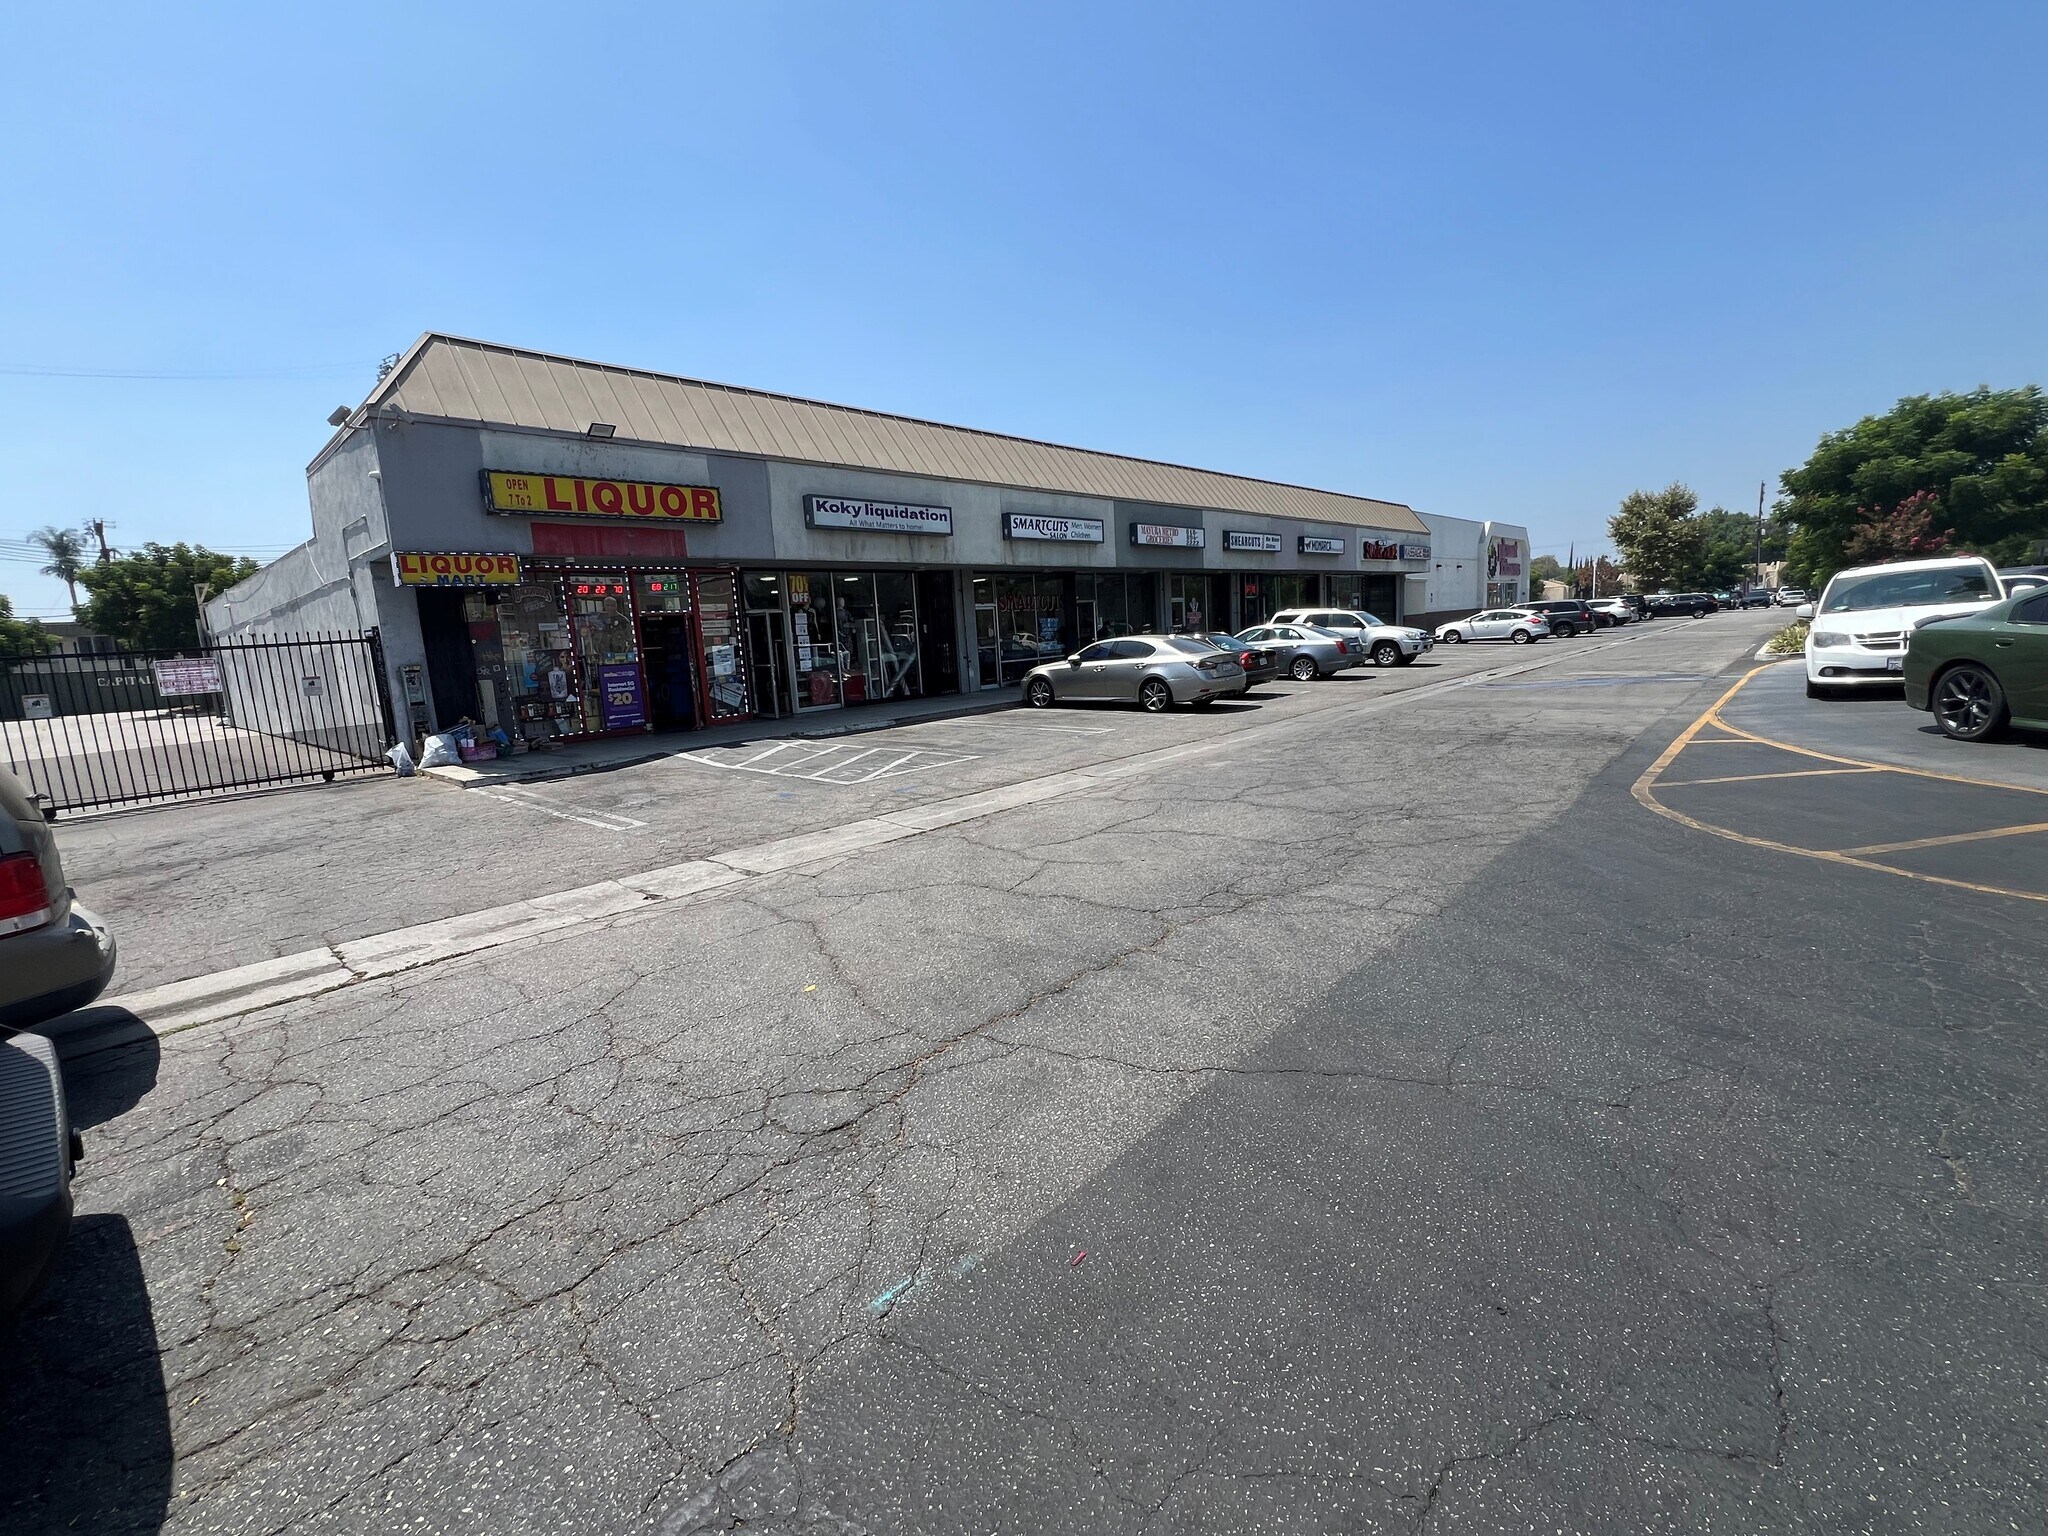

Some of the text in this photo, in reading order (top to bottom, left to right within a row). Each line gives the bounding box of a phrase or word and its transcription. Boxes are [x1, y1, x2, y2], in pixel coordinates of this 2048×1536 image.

[506, 478, 529, 491] OPEN
[508, 494, 514, 505] 7
[527, 496, 532, 506] 2
[543, 477, 718, 519] LIQUOR
[815, 499, 948, 522] Koky liquidation
[849, 519, 858, 527] All
[859, 520, 875, 528] What
[876, 521, 899, 530] Matters
[899, 522, 905, 530] to
[1012, 517, 1069, 536] SMARTCUTS
[1071, 531, 1091, 539] Children
[400, 555, 515, 575] LIQUOR
[436, 574, 486, 585] MART
[577, 585, 623, 594] 20 22 70
[792, 592, 809, 603] OFF
[97, 675, 154, 687] CAPITAL
[608, 692, 633, 705] $20
